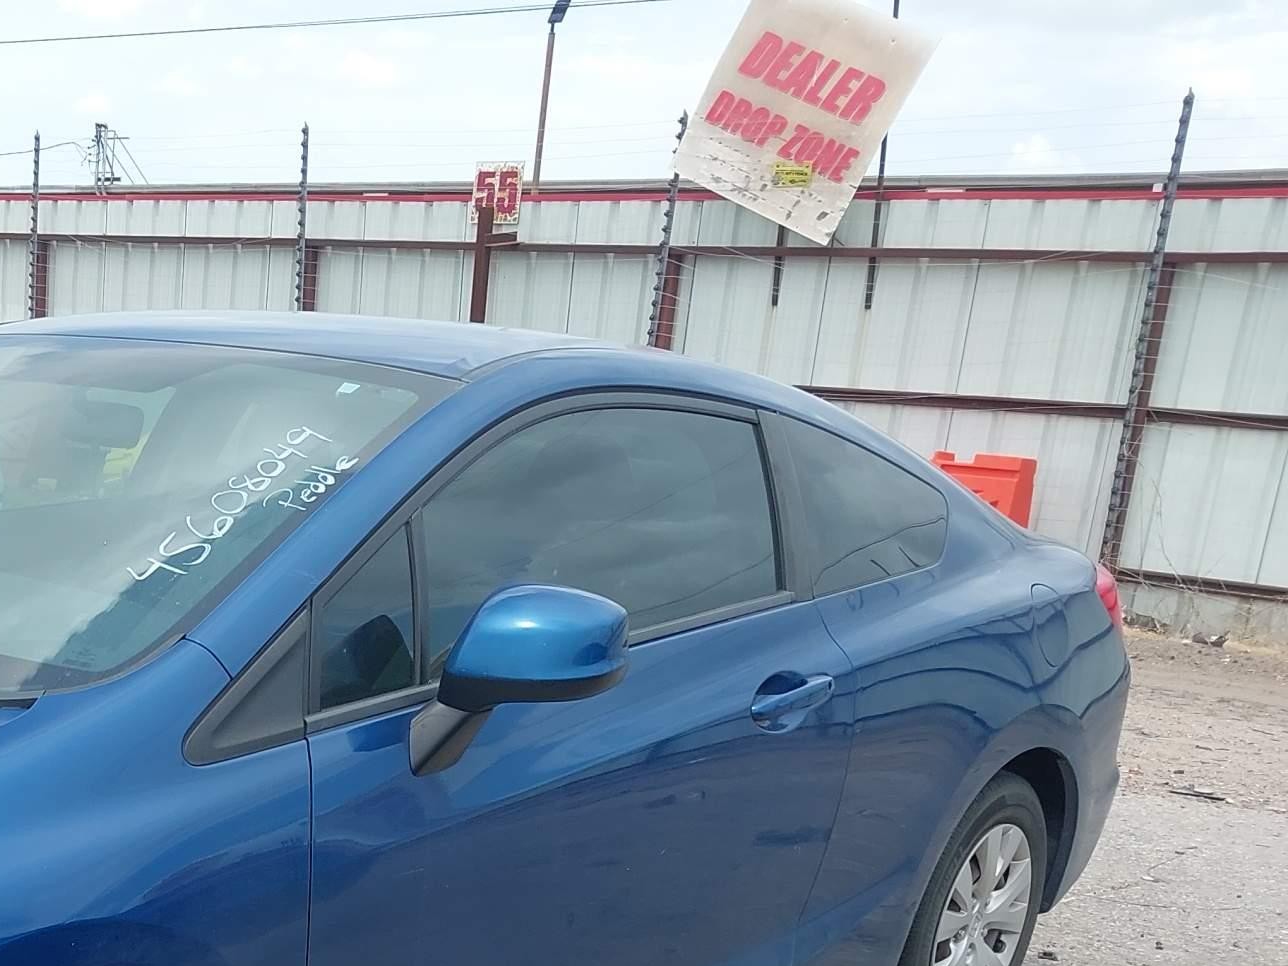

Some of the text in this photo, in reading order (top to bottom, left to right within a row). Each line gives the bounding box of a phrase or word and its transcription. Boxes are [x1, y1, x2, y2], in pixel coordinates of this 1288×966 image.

[738, 31, 886, 122] DEALER
[704, 90, 860, 184] DROP ZONE
[475, 171, 519, 214] 55
[126, 426, 333, 581] 45608049
[263, 455, 360, 511] Peddle
